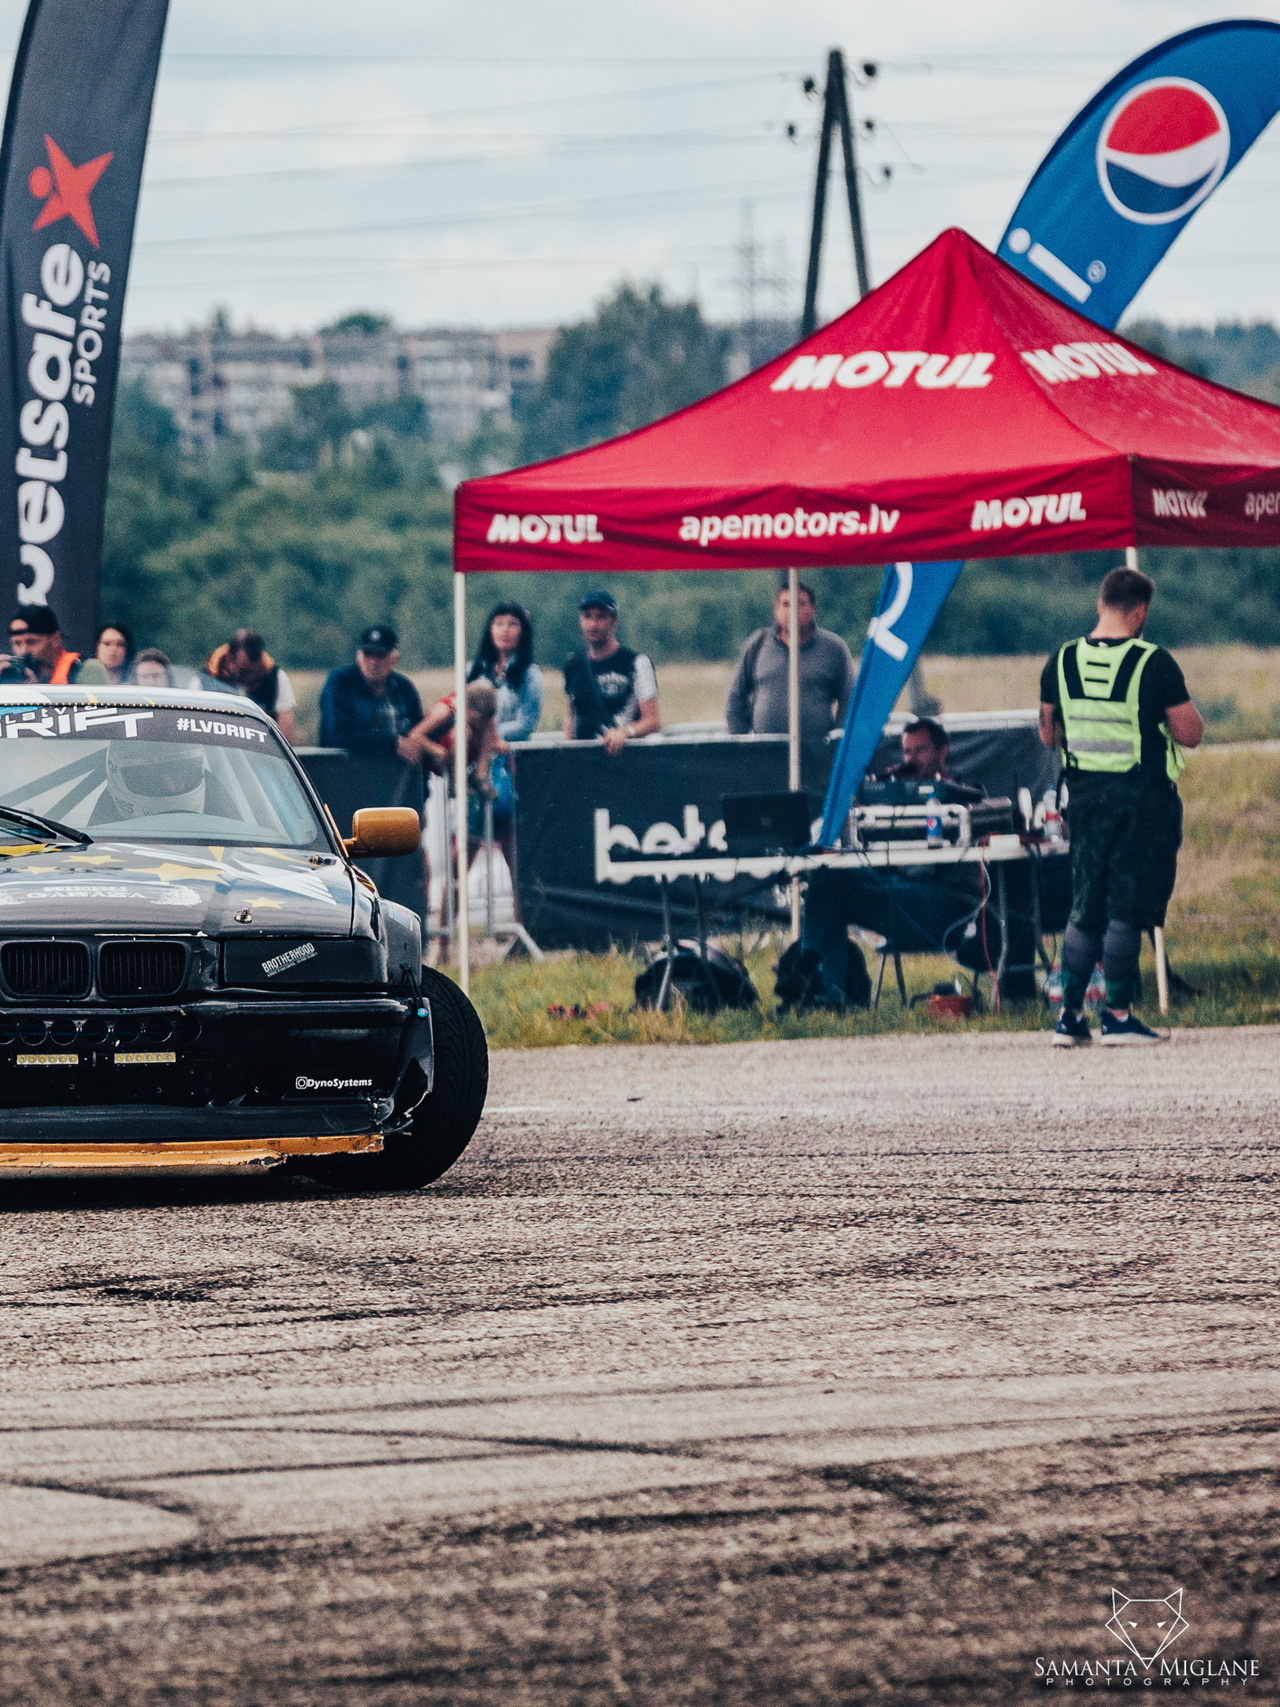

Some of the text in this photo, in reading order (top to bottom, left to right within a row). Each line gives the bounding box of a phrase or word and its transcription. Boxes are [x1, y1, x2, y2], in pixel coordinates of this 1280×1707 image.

[72, 260, 111, 407] SPORTS
[770, 350, 995, 391] MOTUL
[1020, 342, 1159, 384] MOTUL
[970, 491, 1086, 531] MOTUL
[1151, 487, 1208, 518] MOTUL
[487, 513, 604, 543] MOTUL
[679, 503, 900, 547] apemotors.lv
[176, 718, 267, 742] #LVDRIFT
[261, 942, 315, 973] BROTHERHOOD
[307, 1078, 372, 1090] DynoSystems
